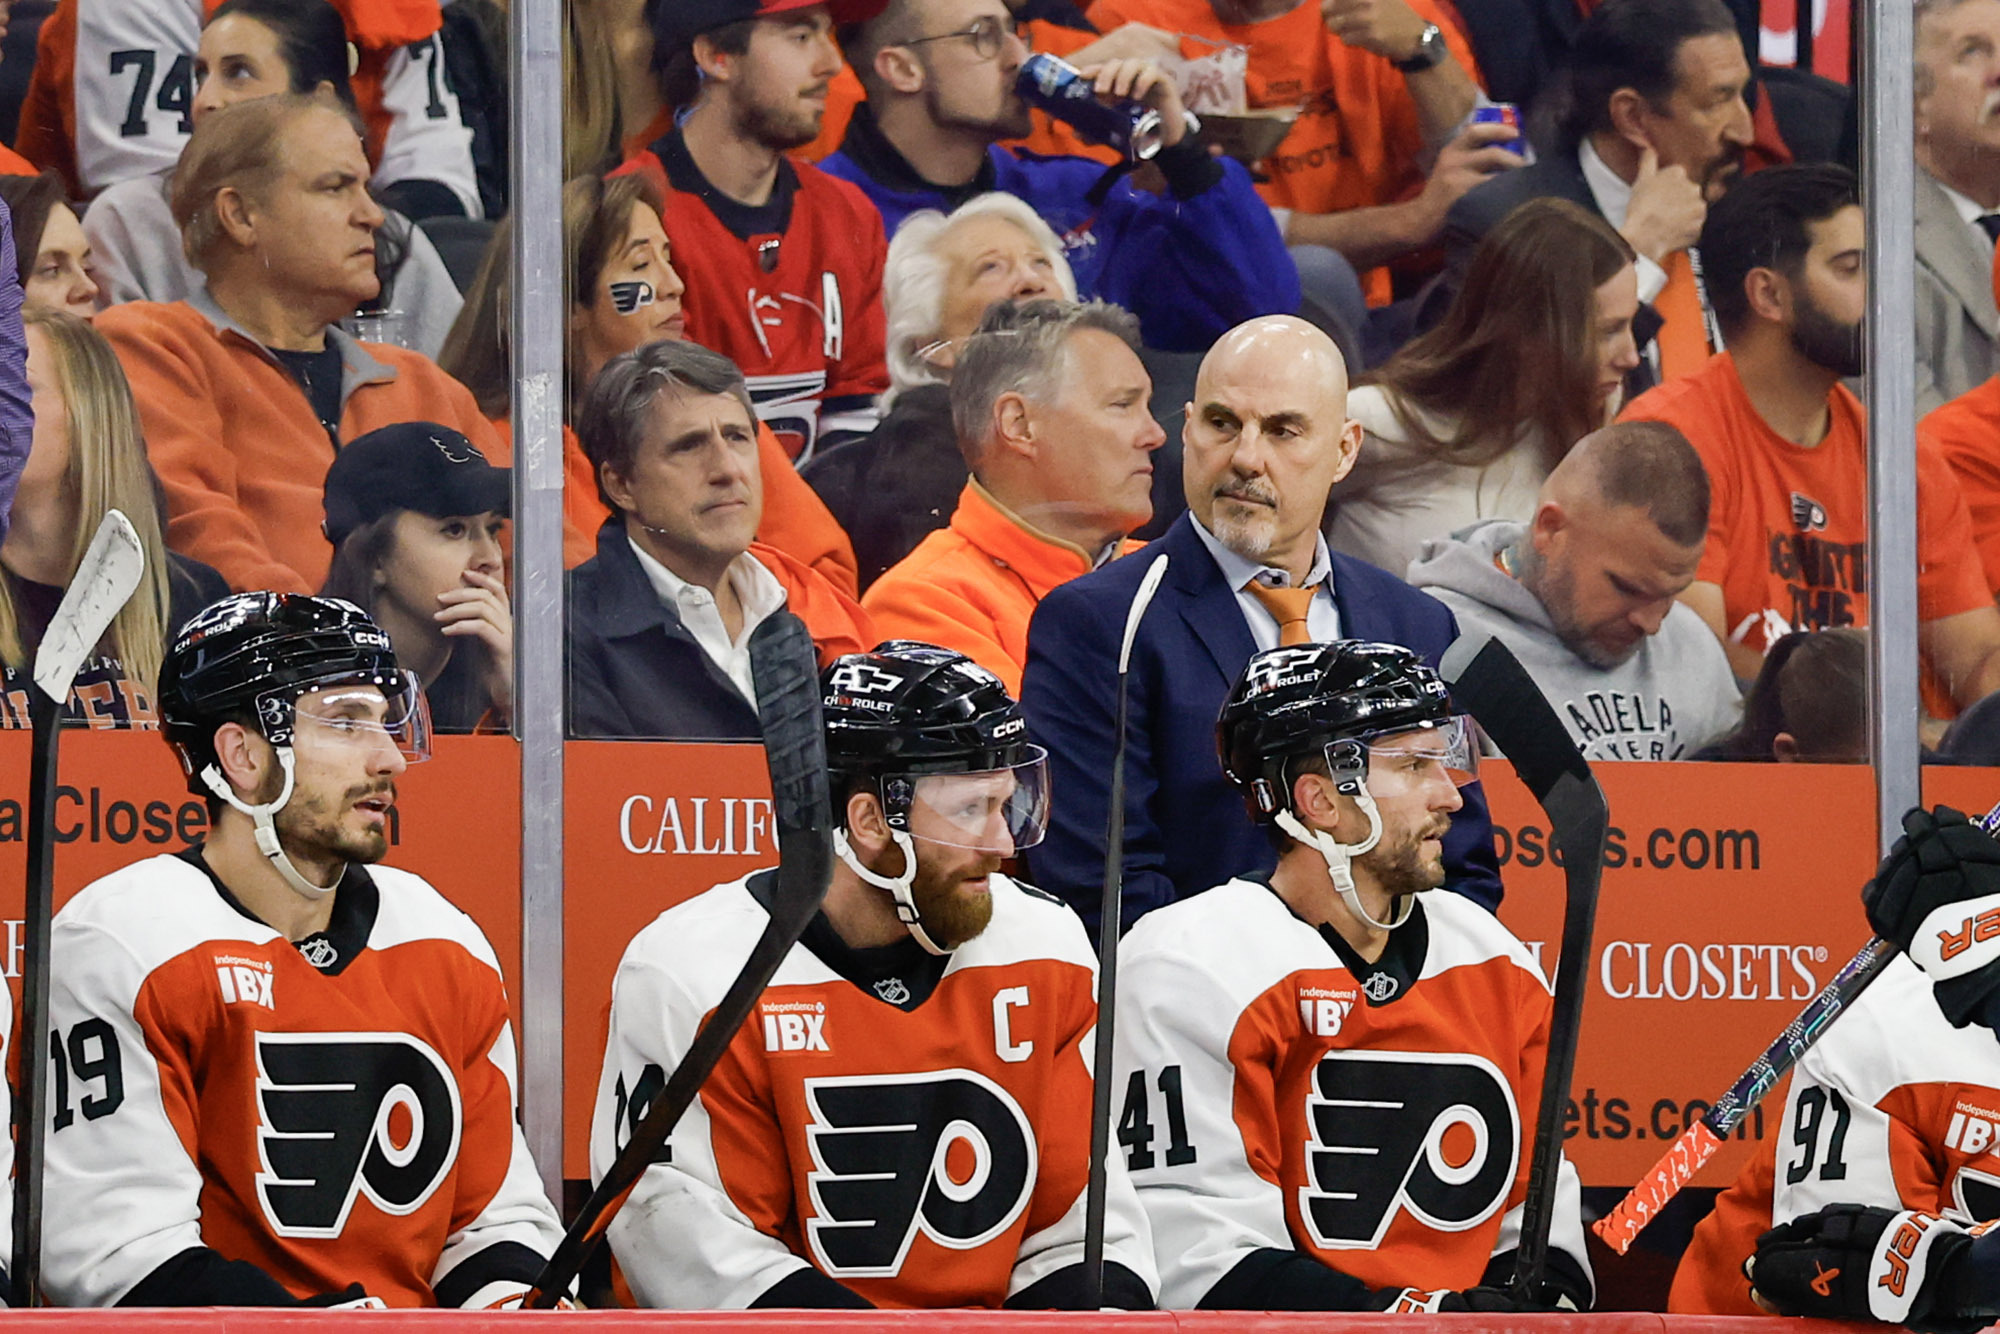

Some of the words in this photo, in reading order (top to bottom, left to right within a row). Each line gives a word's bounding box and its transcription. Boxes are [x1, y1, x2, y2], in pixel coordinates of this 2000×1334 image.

[110, 49, 194, 137] 74
[822, 271, 844, 361] A
[354, 631, 390, 649] CCM
[992, 717, 1025, 739] CCM
[619, 794, 781, 855] CALIF
[216, 966, 275, 1011] IBX
[762, 1002, 815, 1014] Independence
[763, 1013, 831, 1052] IBX
[992, 985, 1034, 1063] C
[50, 1016, 125, 1134] 19
[1116, 1065, 1197, 1172] 41
[1786, 1085, 1851, 1186] 91
